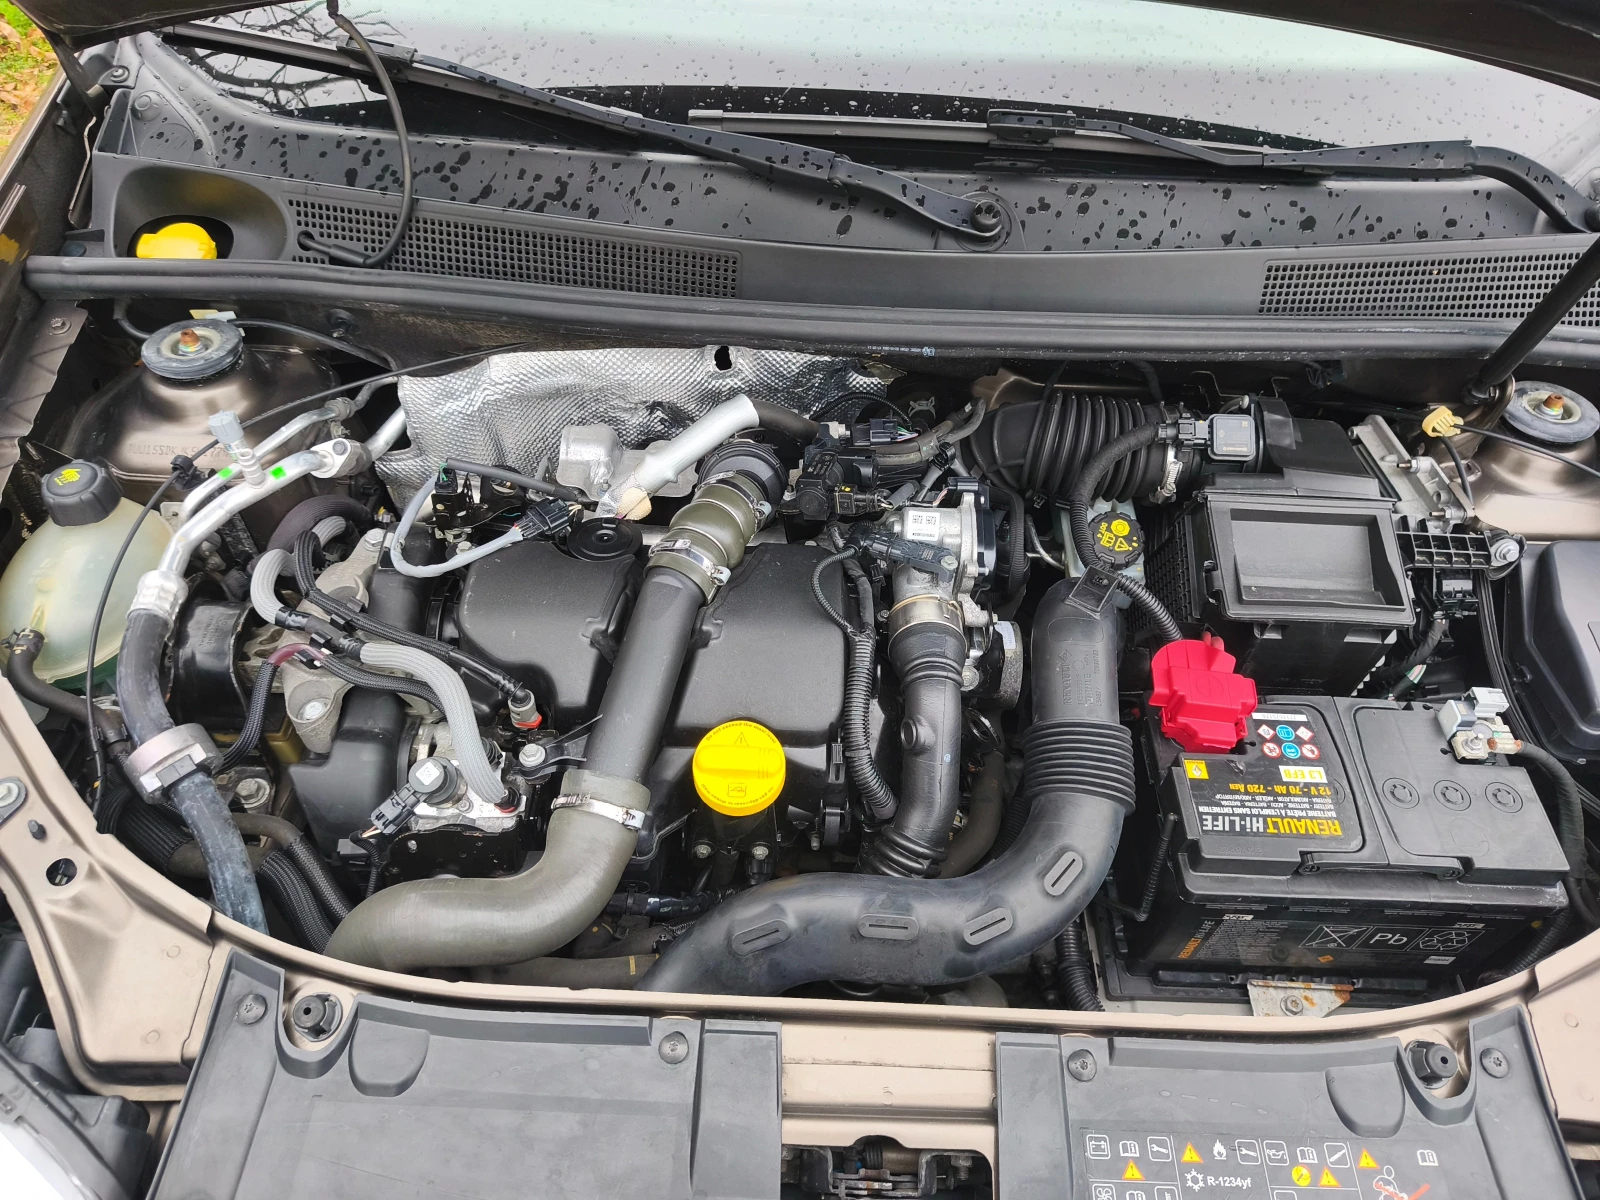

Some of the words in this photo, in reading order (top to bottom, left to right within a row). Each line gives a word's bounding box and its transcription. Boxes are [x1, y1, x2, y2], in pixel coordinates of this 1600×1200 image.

[1061, 663, 1072, 705] RENAULT
[1283, 769, 1305, 778] EFB
[1309, 770, 1322, 779] L3
[1247, 784, 1266, 793] 720
[1274, 785, 1286, 793] Ah
[1289, 786, 1302, 794] 70
[1311, 786, 1318, 795] V
[1318, 787, 1331, 795] 12
[1202, 815, 1264, 831] Hi-LIFE
[1266, 817, 1342, 836] RENAULT
[1370, 933, 1408, 945] Pb
[1206, 1175, 1252, 1188] R-1234yf
